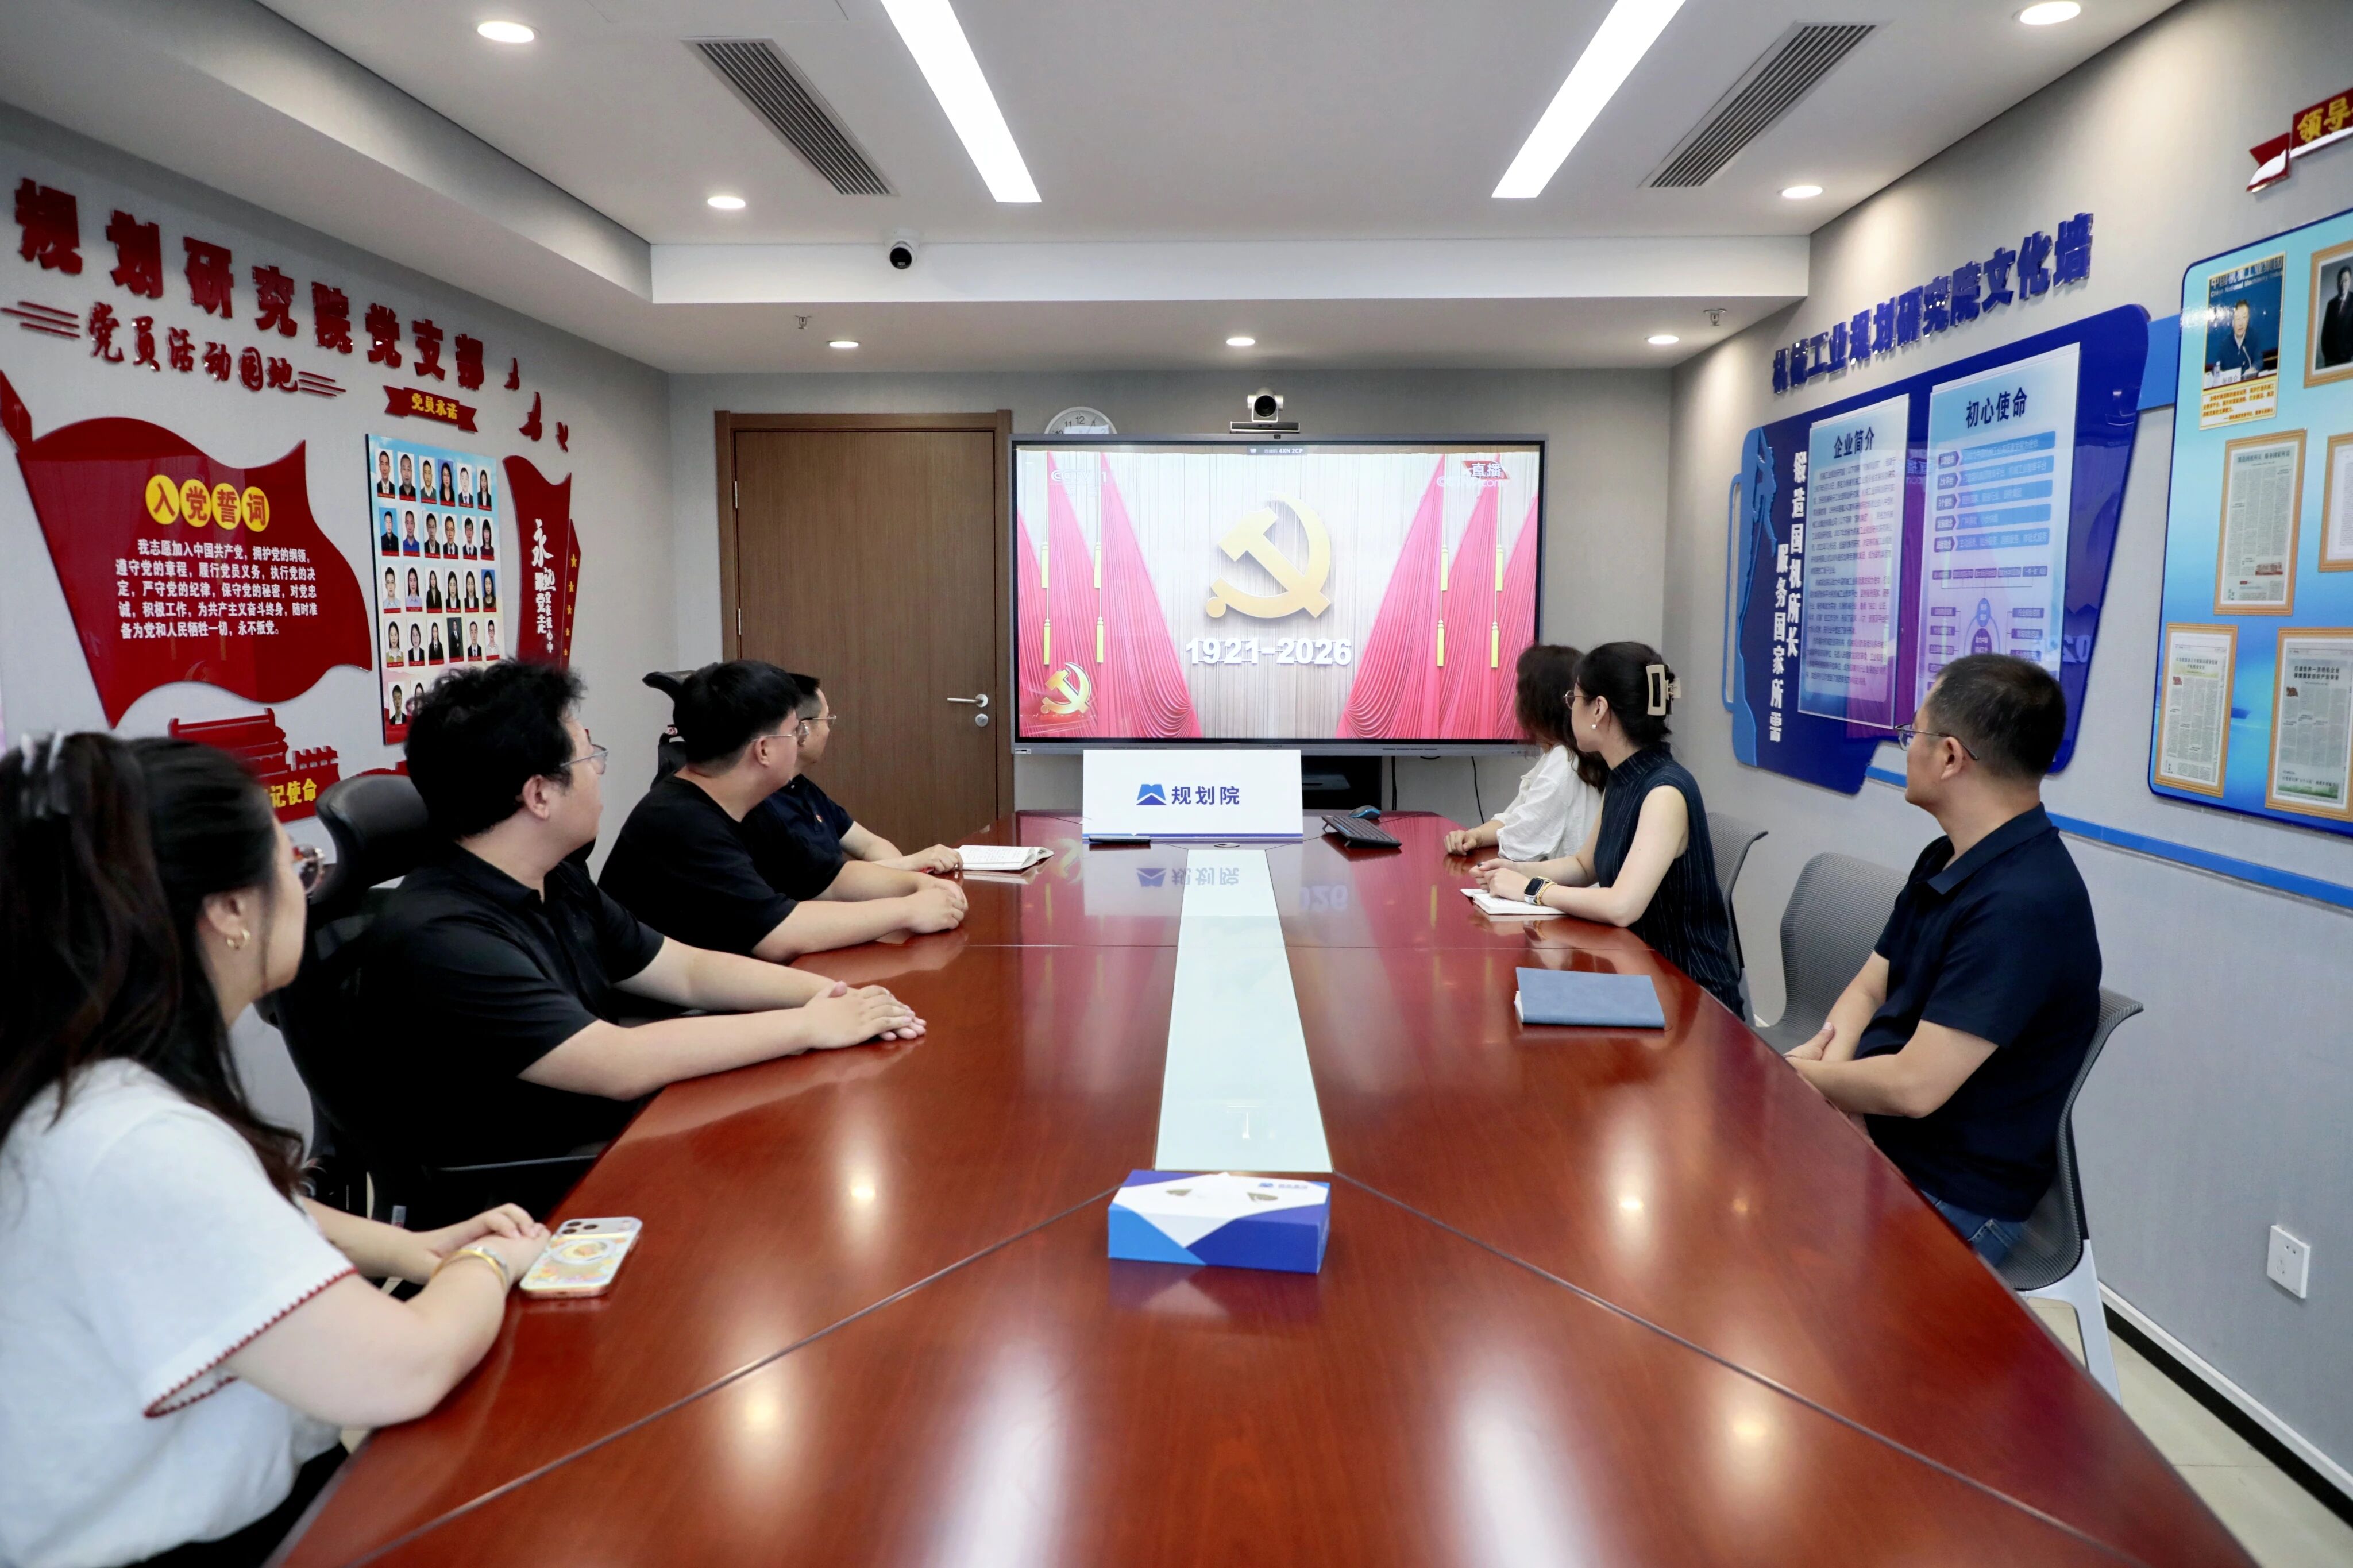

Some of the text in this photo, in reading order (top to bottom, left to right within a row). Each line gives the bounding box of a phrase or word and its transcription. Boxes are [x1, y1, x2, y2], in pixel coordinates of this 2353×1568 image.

[2297, 96, 2353, 142] 领导
[14, 178, 484, 391] 规划研究院党支部
[1772, 211, 2094, 394] 机械工业规划研究院文化墙
[87, 302, 298, 392] 党员活动园地
[411, 393, 458, 420] 党员承诺
[1075, 416, 1085, 424] 12
[1965, 387, 2027, 429] 初心使命
[1834, 426, 1874, 459] 企业简介
[1472, 463, 1501, 477] 直播
[153, 482, 265, 526] 入党誓词
[137, 538, 311, 563] 我志愿加入中国共产党，拥护党的纲领，
[115, 558, 316, 581] 遵守党的章程，履行党员义务，执行党的决
[117, 580, 317, 598] 定，严守党的纪律，保守党的秘密，对党忠
[118, 601, 318, 618] 诚，积极工作，为共产主义奋斗终身，随时准
[121, 620, 279, 639] 备为党和人民牺牲一切，永不叛党。
[1770, 544, 1789, 742] 服务国家所需
[1186, 638, 1351, 665] 1921-2026
[264, 778, 317, 808] 记使命
[1171, 786, 1240, 805] 规划院
